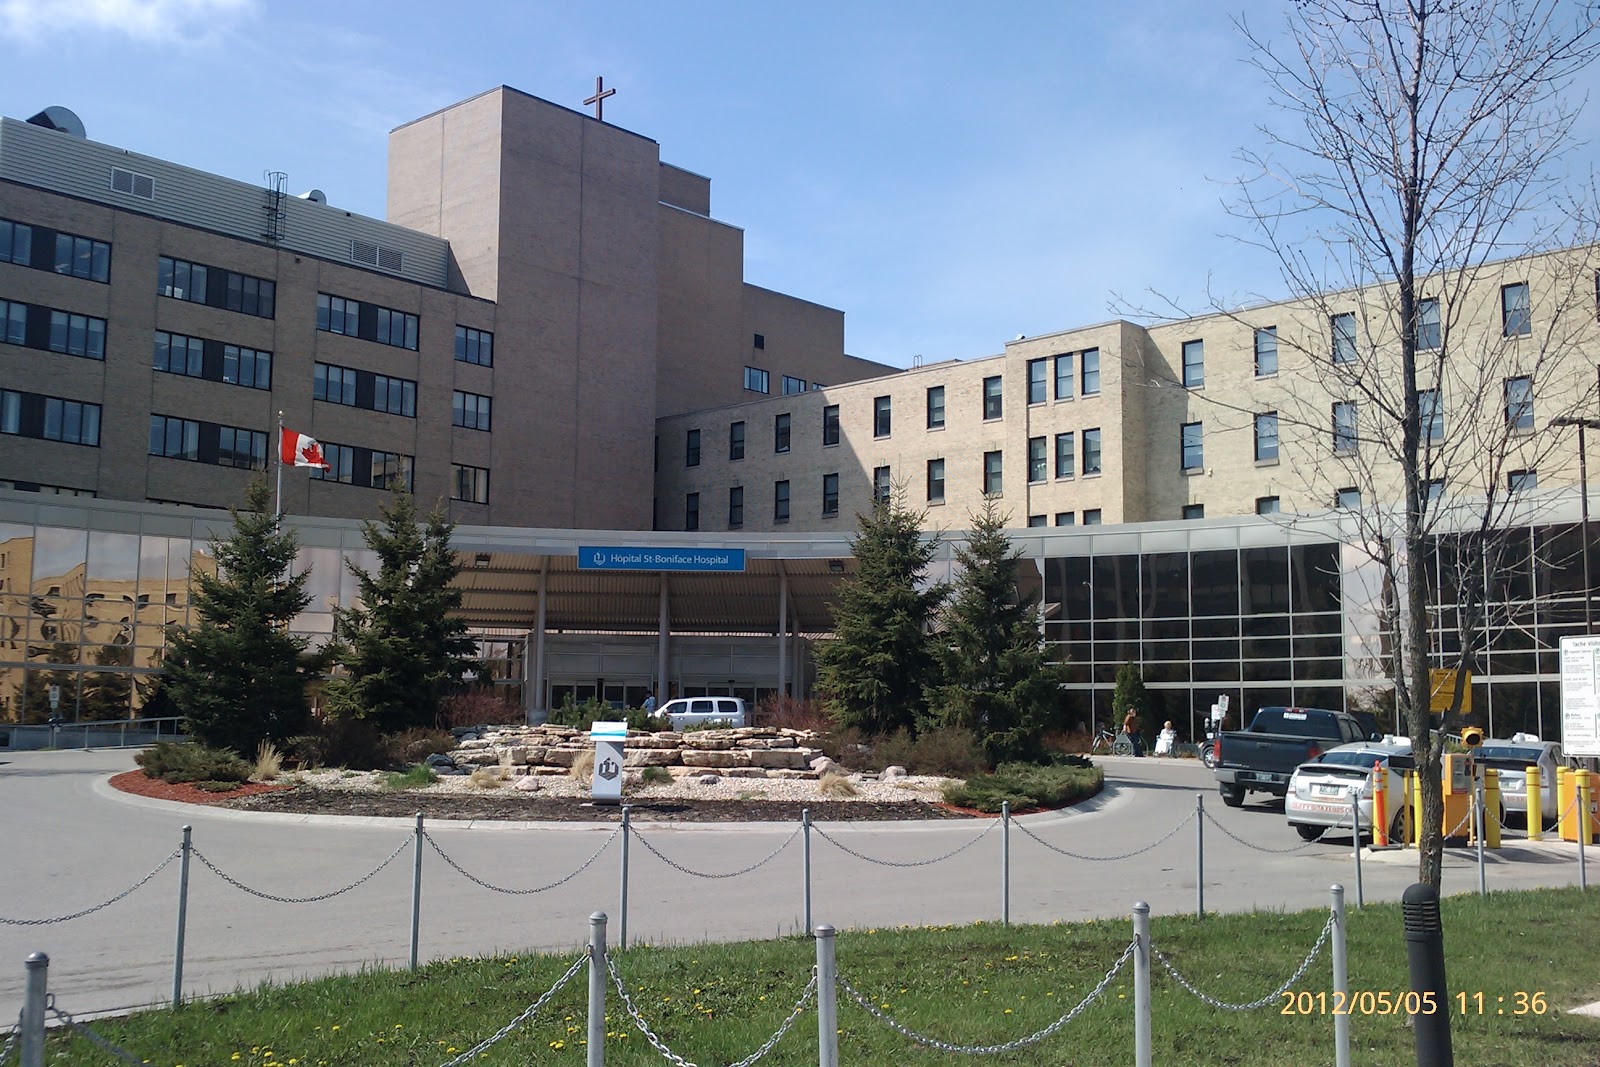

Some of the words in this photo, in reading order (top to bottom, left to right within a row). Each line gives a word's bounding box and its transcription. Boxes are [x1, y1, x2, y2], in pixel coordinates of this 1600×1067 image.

[643, 554, 693, 564] St-Boniface
[693, 555, 729, 566] Hospital
[1347, 785, 1364, 796] 276
